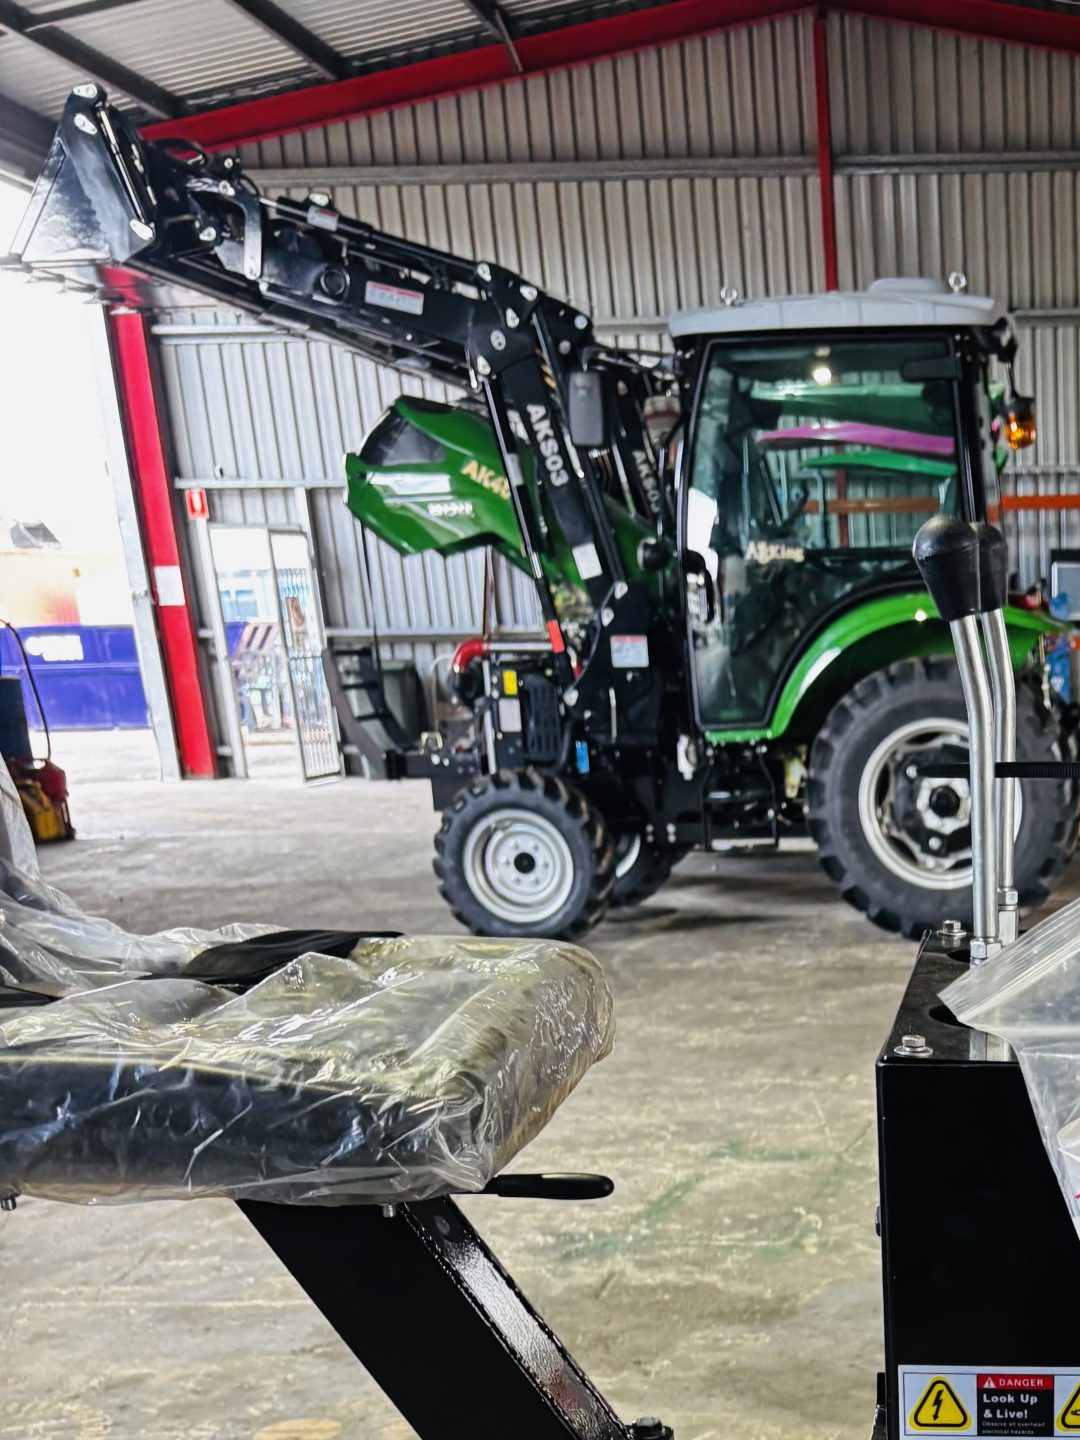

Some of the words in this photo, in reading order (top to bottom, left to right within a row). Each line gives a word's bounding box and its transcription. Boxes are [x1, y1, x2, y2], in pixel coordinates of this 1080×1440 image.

[526, 403, 569, 487] AKS03
[999, 1378, 1044, 1387] DANGER
[983, 1393, 1015, 1404] Look
[1020, 1393, 1038, 1405] Up
[983, 1409, 993, 1419] &
[996, 1409, 1029, 1419] Live!
